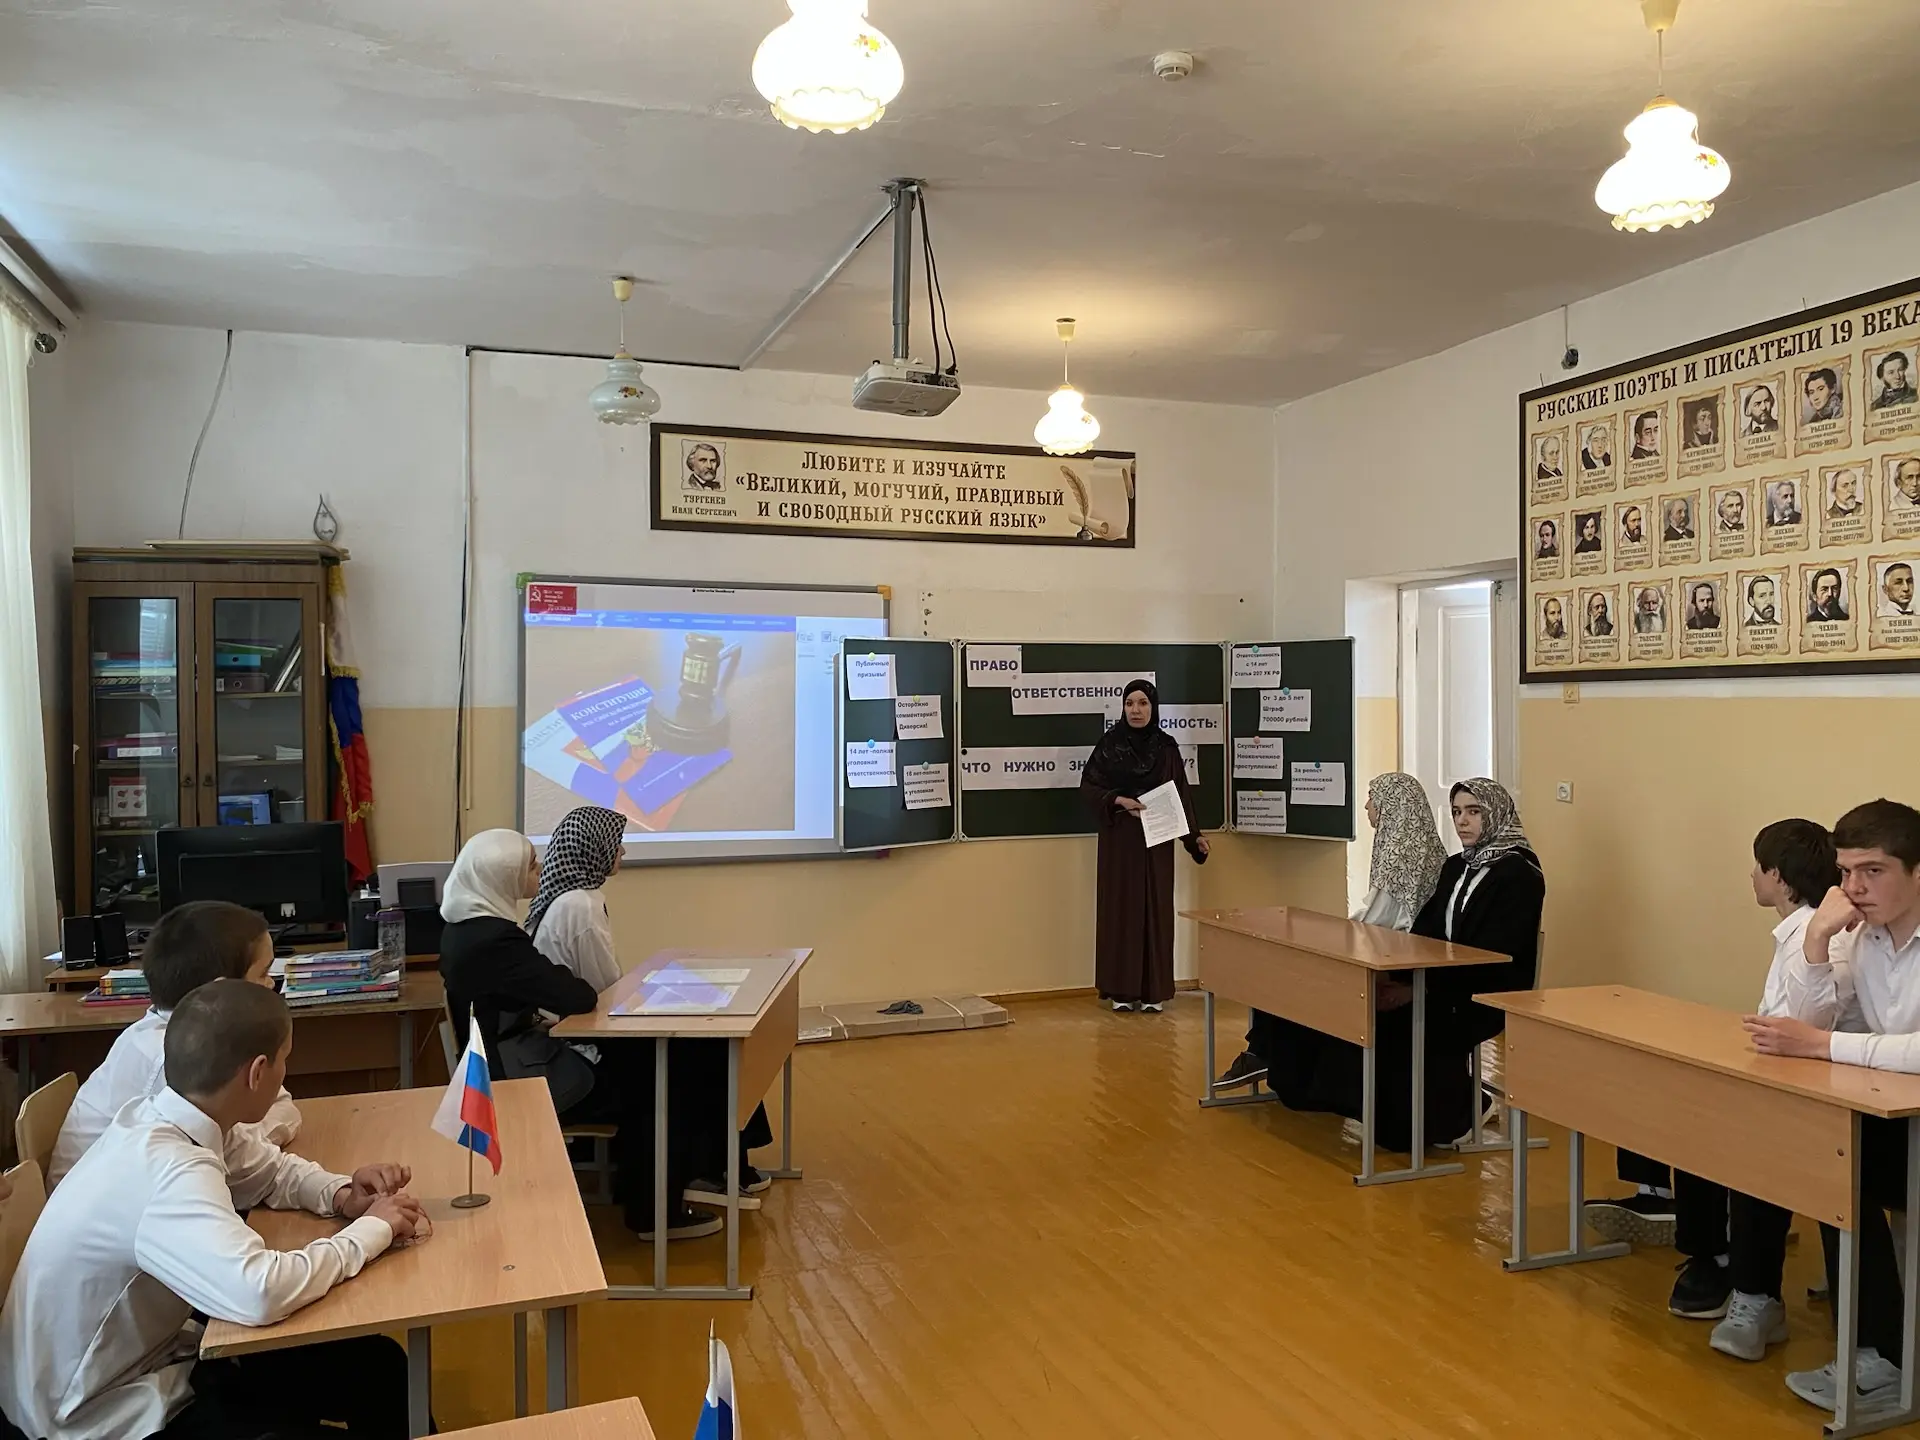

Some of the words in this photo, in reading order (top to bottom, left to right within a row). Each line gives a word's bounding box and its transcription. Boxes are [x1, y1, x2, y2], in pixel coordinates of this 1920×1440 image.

[1537, 386, 1609, 422] РУССКИЕ
[1614, 367, 1678, 402] ПОЭТЫ
[1684, 361, 1698, 384] И
[1704, 326, 1823, 379] ПИСАТЕЛИ
[1830, 319, 1853, 346] 19
[1861, 300, 1920, 337] ВЕКА
[802, 451, 886, 474] ЛЮБИТЕ
[893, 459, 905, 475] И
[912, 460, 1006, 480] ИЗУЧАЙТЕ
[736, 472, 847, 499] «ВЕЛИКИЙ,
[853, 481, 950, 504] МОГУЧИЙ,
[956, 487, 1065, 506] ПРАВДИВЫЙ
[683, 494, 727, 505] ТУРГЕНЕВ
[757, 501, 771, 517] И
[778, 502, 894, 524] СВОБОДНЫЙ
[900, 507, 983, 526] РУССКИЙ
[989, 512, 1047, 529] ЯЗЫК»
[855, 660, 889, 668] Публичные
[970, 659, 1019, 671] ПРАВО
[857, 671, 886, 679] призывы!
[1012, 686, 1123, 699] ОТВЕТСТВЕННО
[897, 701, 929, 709] Осторожно
[1262, 705, 1285, 713] Штраф
[1285, 716, 1309, 724] рублей
[899, 722, 928, 730] Диверсия!
[847, 759, 878, 767] уголовная
[962, 762, 991, 773] ЧТО
[1003, 760, 1056, 773] НУЖНО
